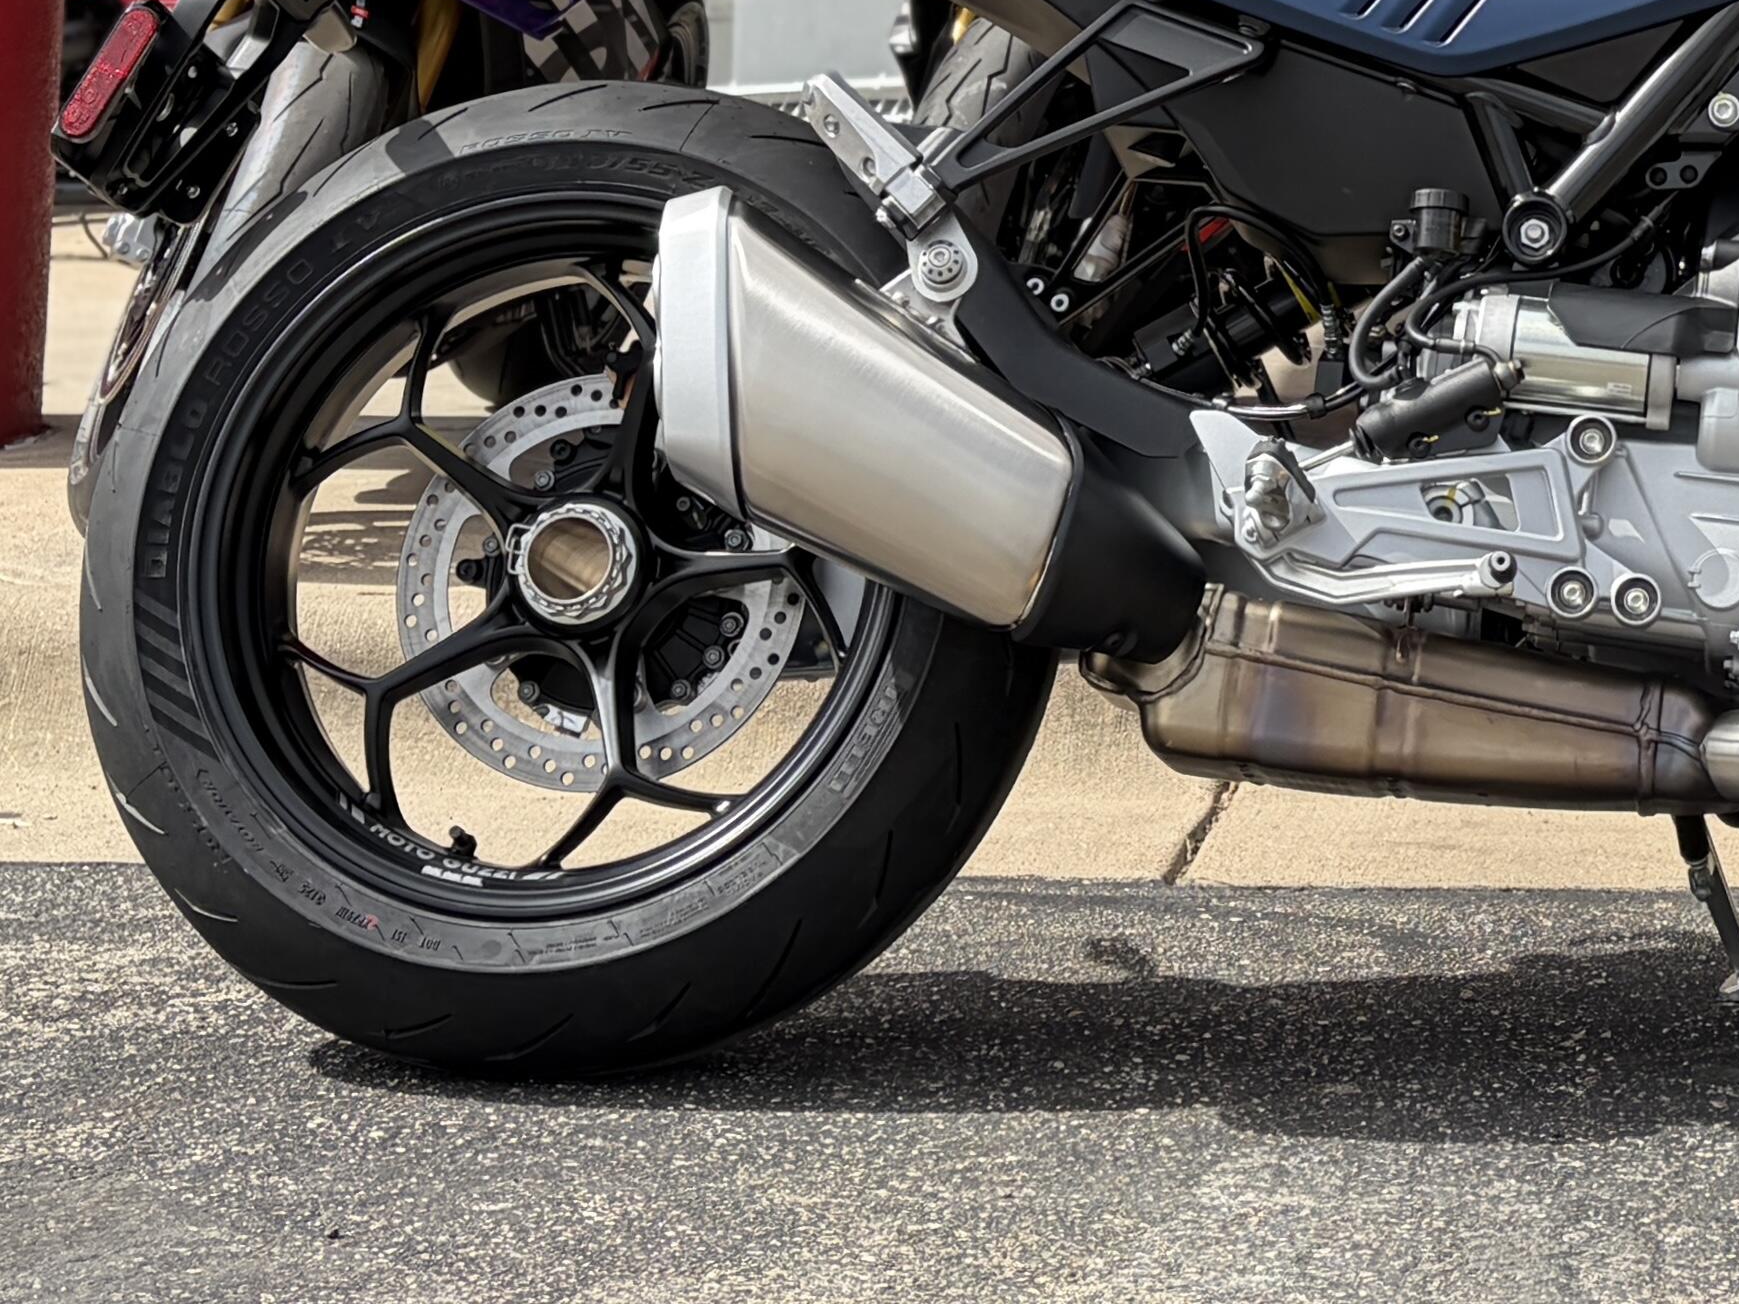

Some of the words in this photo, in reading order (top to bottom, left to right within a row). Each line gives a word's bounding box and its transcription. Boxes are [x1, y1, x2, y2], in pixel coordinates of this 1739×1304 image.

[204, 257, 316, 388] ROSSO
[829, 673, 912, 794] IRELLI
[370, 822, 436, 862] MOTO
